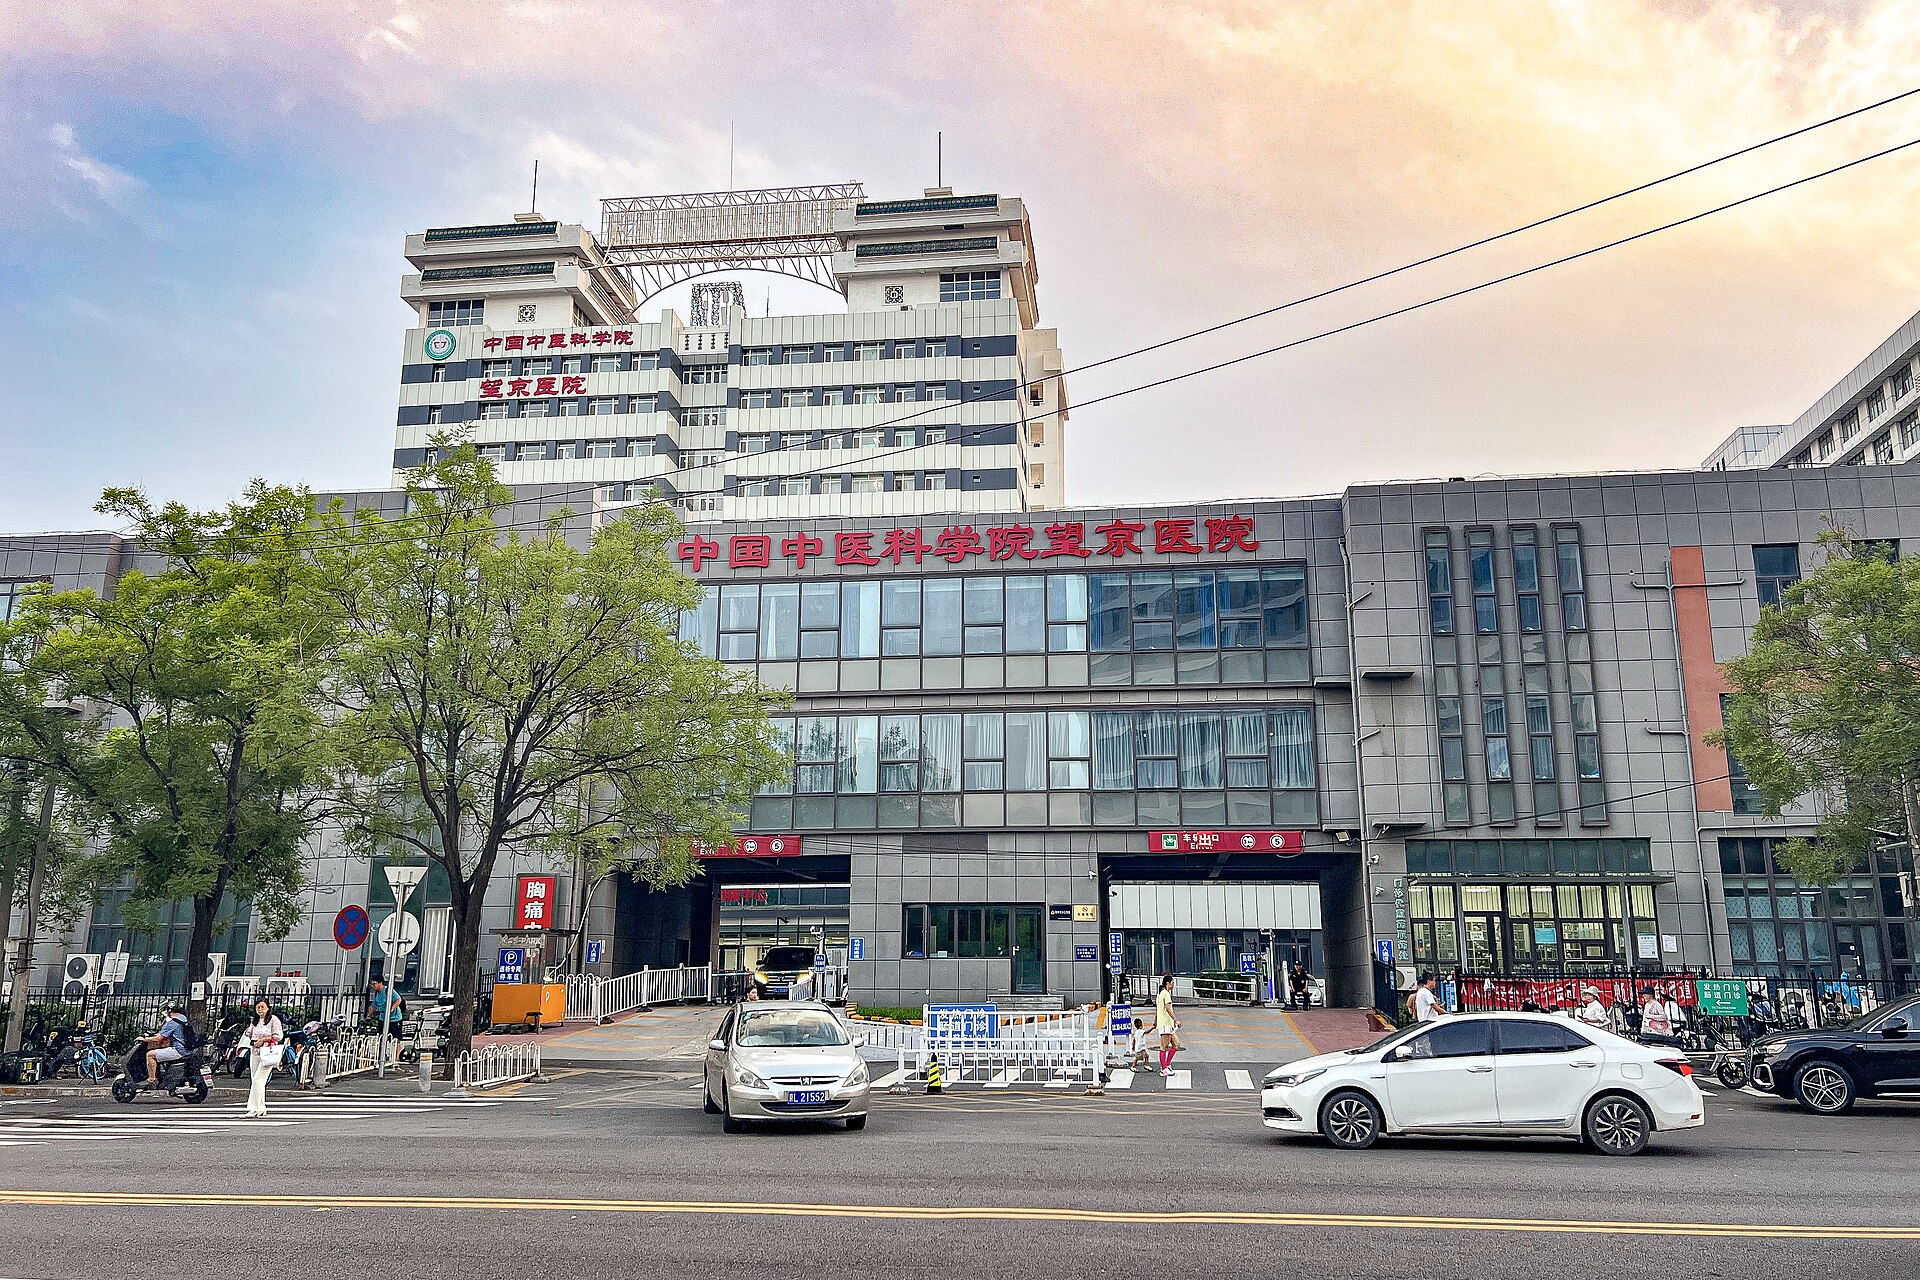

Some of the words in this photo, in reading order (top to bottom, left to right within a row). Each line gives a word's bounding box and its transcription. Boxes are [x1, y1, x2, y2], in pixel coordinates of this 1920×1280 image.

[483, 330, 634, 353] 中国中医科学院
[479, 376, 587, 399] 望京医院
[677, 513, 1259, 572] 中国中医科学院望京医院
[1703, 983, 1740, 991] 发热门诊
